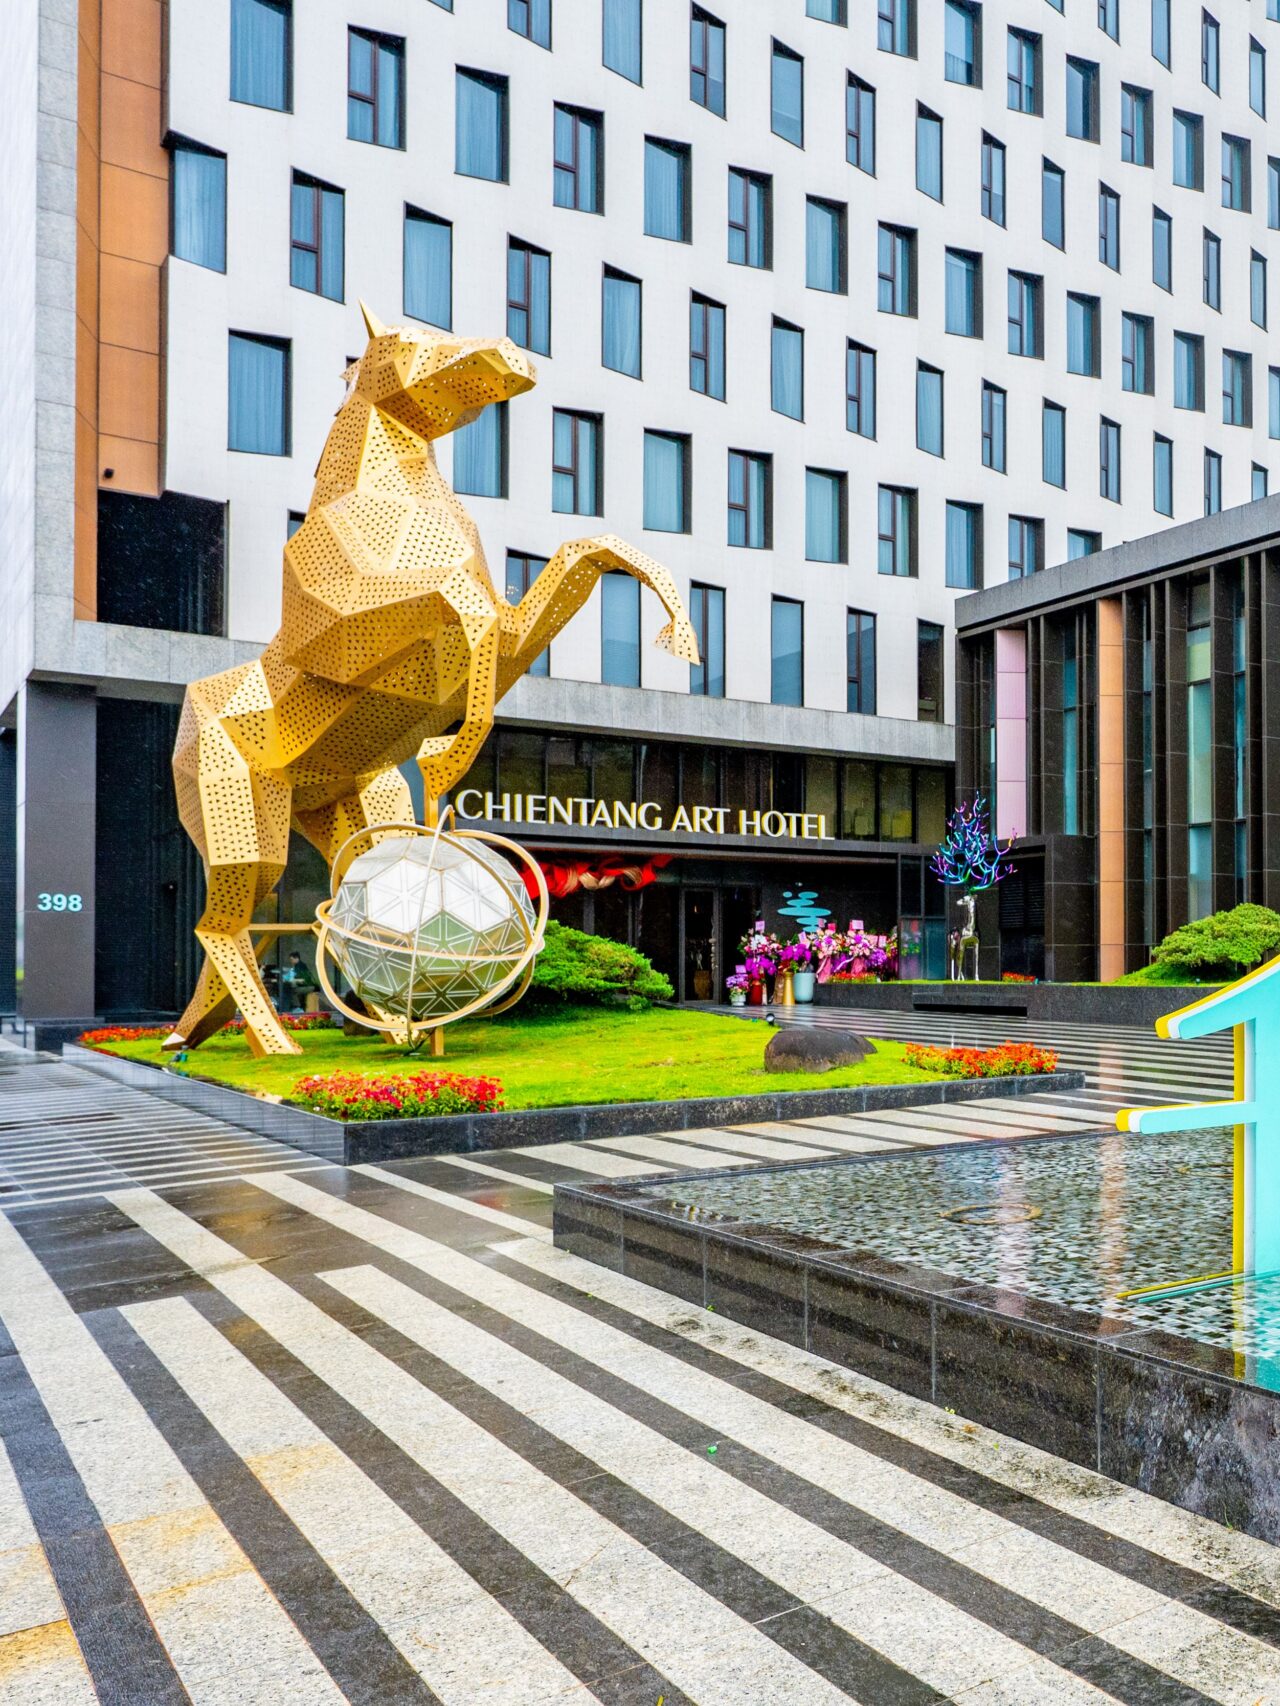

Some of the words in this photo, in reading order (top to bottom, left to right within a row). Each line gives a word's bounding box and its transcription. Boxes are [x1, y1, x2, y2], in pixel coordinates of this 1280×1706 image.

[455, 789, 662, 831] CHIENTANG
[671, 805, 731, 834] ART
[739, 810, 835, 841] HOTEL
[37, 893, 83, 911] 398
